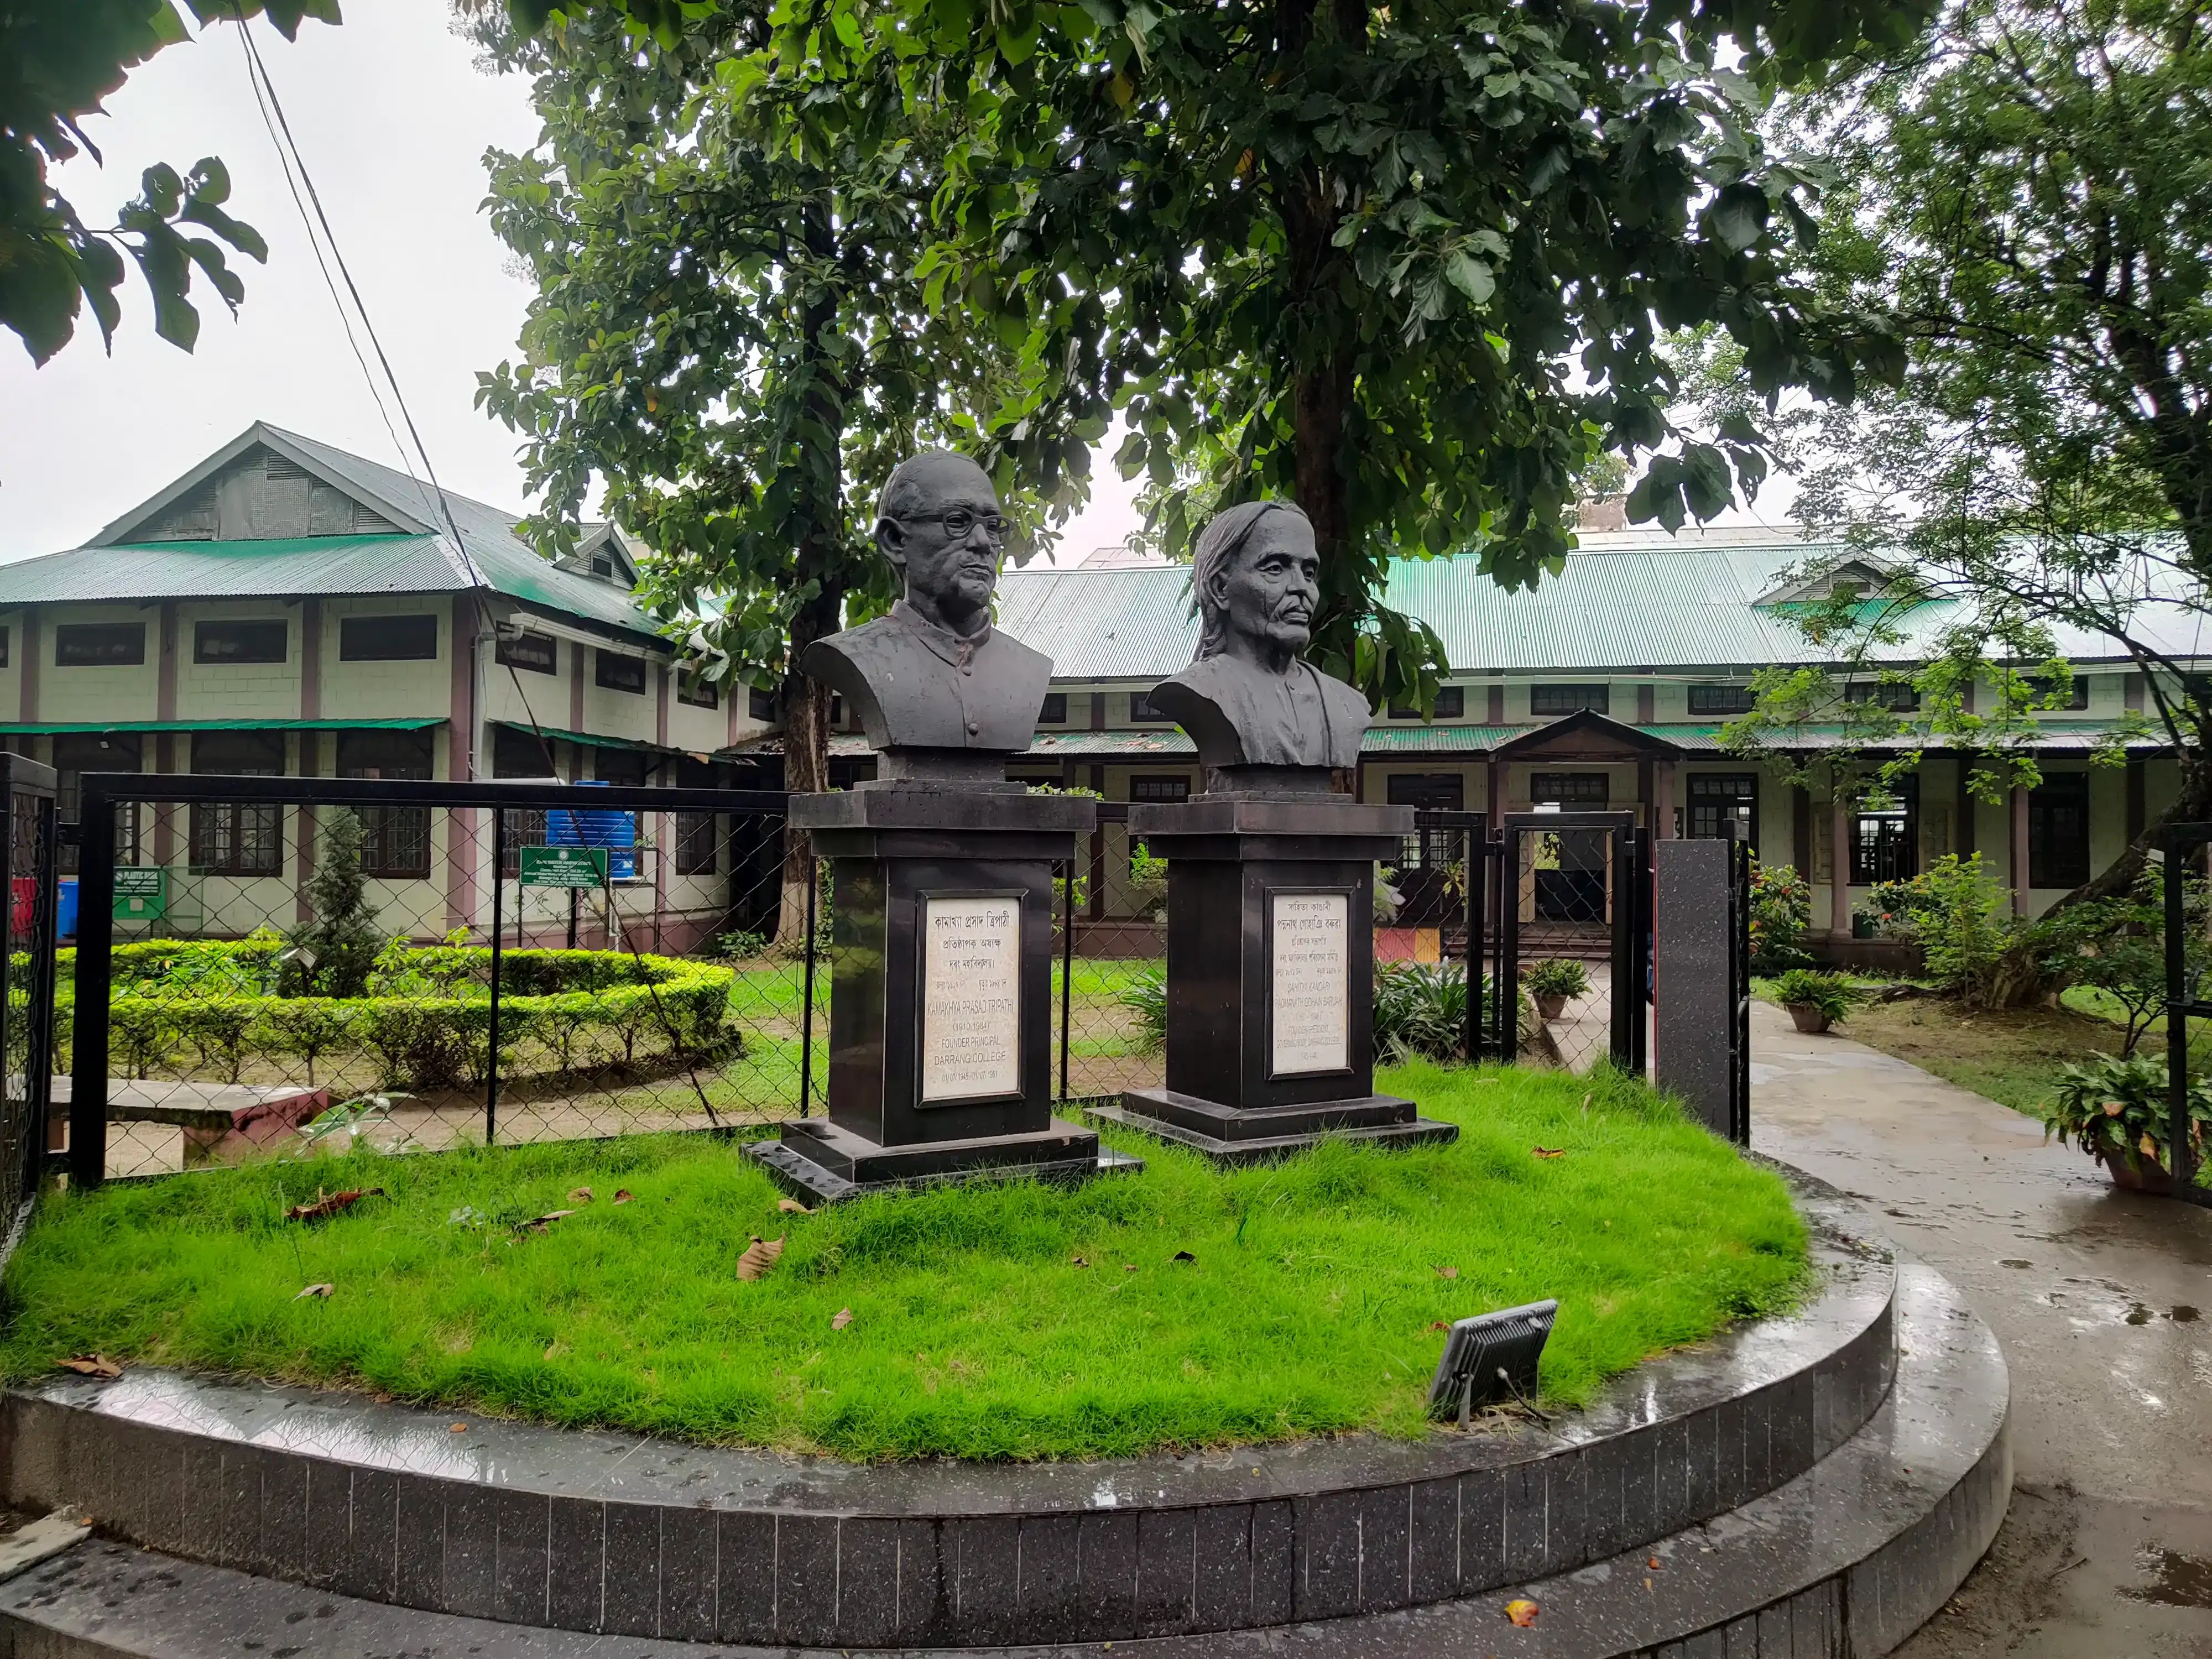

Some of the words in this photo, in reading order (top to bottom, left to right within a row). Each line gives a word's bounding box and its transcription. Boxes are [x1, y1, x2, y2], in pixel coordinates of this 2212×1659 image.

[934, 914, 962, 930] কামাখ্যা
[927, 1001, 961, 1016] KAMAKHYA
[962, 999, 987, 1014] PRASAD
[988, 998, 1014, 1013] TRIPATHI
[942, 1037, 969, 1048] FOUNDER
[971, 1035, 1000, 1047] PRINCIPAL
[934, 1053, 971, 1066] DARRANG
[972, 1051, 1006, 1063] COLLEGE
